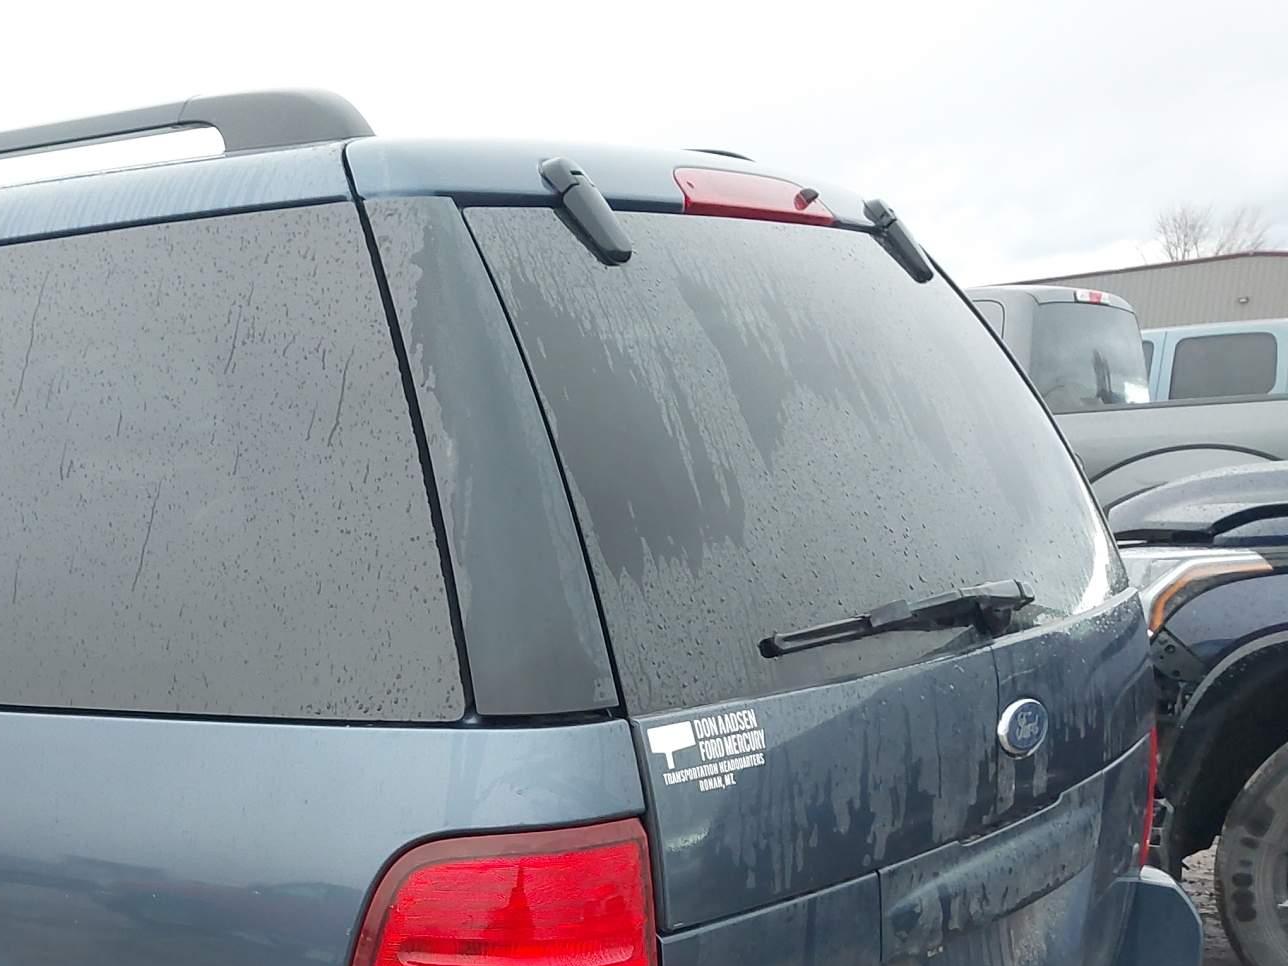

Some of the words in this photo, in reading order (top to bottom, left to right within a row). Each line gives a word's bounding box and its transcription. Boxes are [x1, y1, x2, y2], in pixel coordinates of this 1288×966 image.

[693, 715, 719, 739] DON
[718, 708, 759, 736] AADSEN
[698, 736, 725, 762] FORD
[723, 728, 766, 757] MERCURY
[662, 762, 719, 786] TRANSPORTATION
[718, 752, 765, 773] HEADQUARTERS
